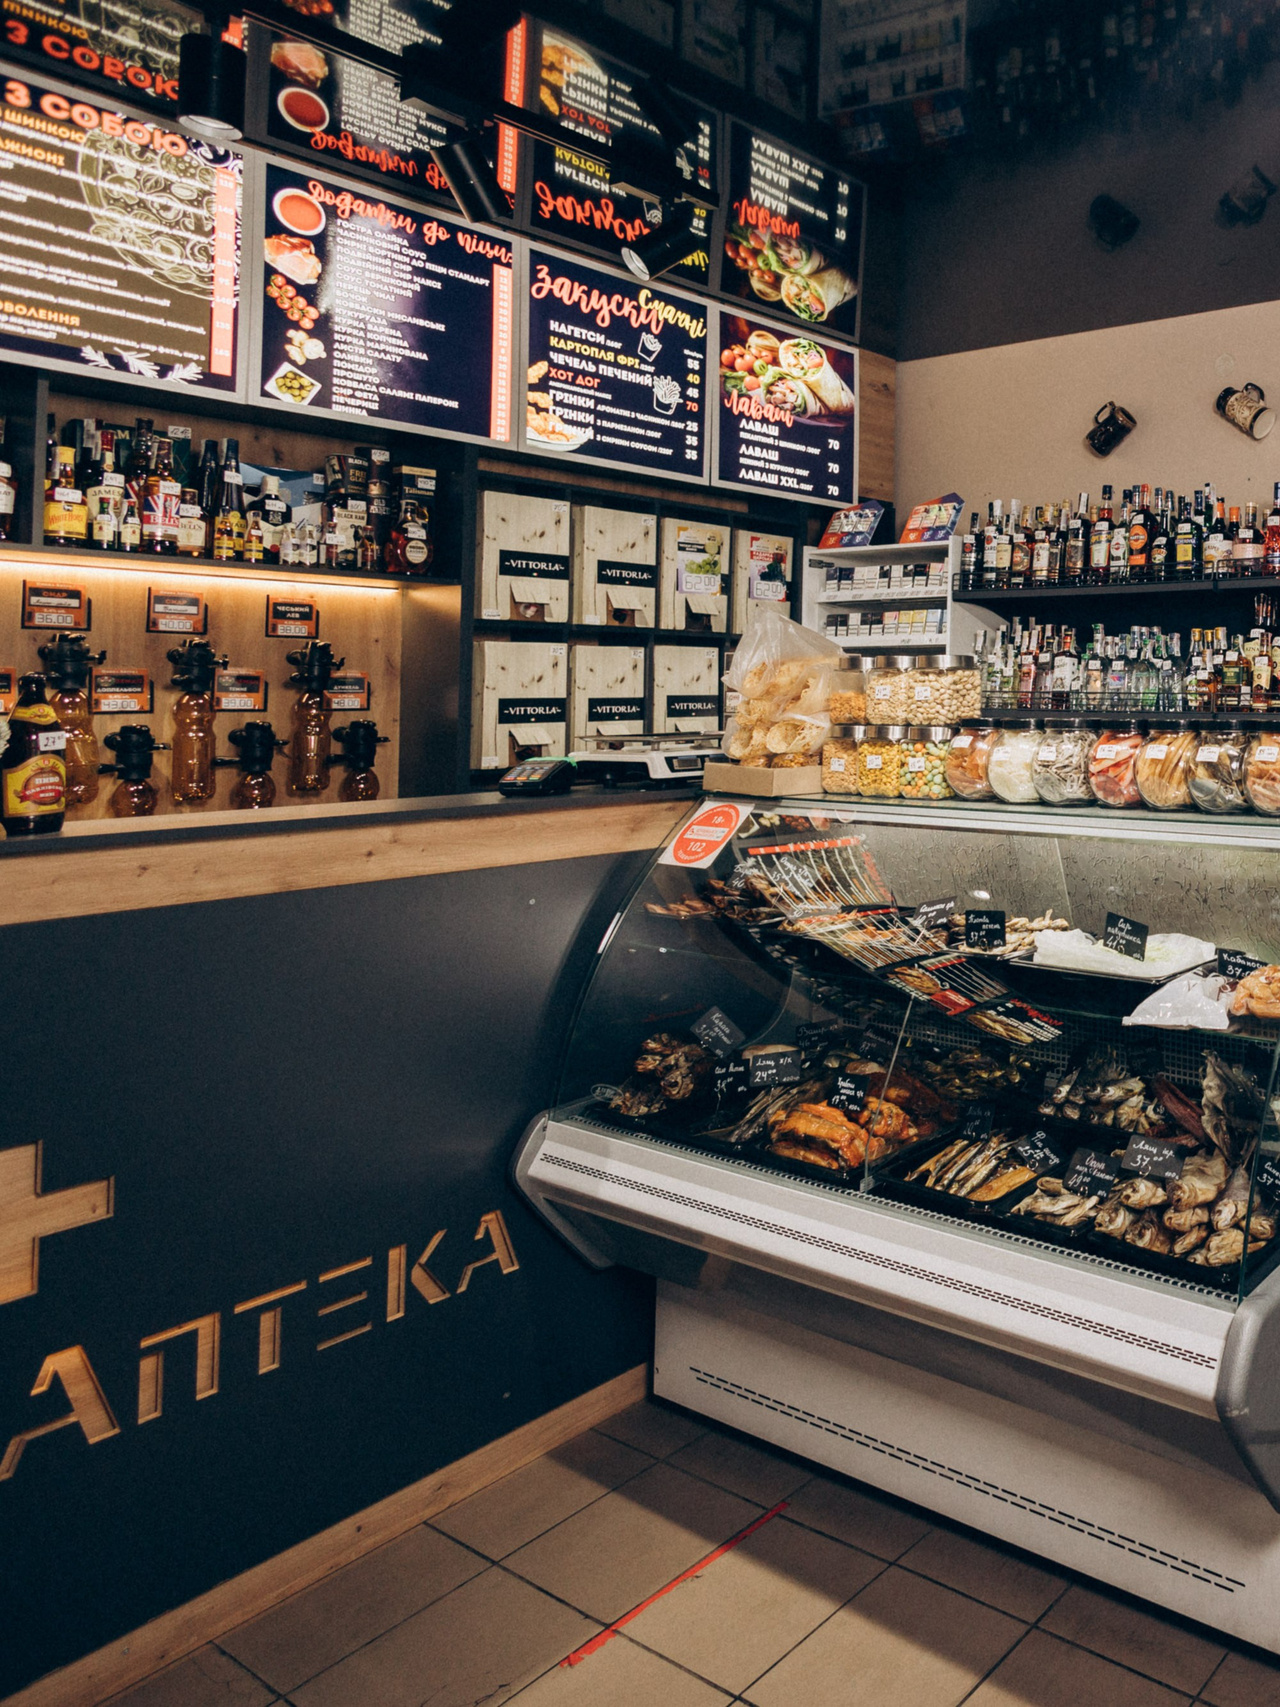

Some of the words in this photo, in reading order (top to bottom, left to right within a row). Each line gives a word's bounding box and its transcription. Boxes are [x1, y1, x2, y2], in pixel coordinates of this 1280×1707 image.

[3, 108, 88, 144] ШИНКОЮ
[4, 80, 31, 109] З
[40, 93, 189, 157] СОБОЮ
[308, 179, 417, 235] Додатки
[422, 220, 451, 246] до
[336, 219, 373, 236] ГОСТРА
[374, 230, 409, 247] ОЛІЙКА
[336, 227, 400, 252] ЧАСНИКОВИЙ
[401, 245, 427, 260] СОУС
[336, 245, 392, 267] ПОДВІЙНИЙ
[393, 261, 413, 272] СИР
[336, 237, 367, 252] СИРНІ
[368, 245, 410, 264] БОРТИКИ
[411, 257, 424, 268] ДО
[447, 268, 490, 286] СТАНДАРТ
[336, 254, 392, 275] ПОДВІЙНИЙ
[392, 269, 412, 281] СИР
[413, 275, 442, 290] МАКСІ
[336, 263, 363, 275] СОУС
[364, 271, 421, 292] ВЕРШКОВИЙ
[335, 281, 372, 297] ПЕРЕЦЬ
[373, 291, 396, 302] ЧИЛІ
[336, 272, 362, 285] СОУС
[364, 279, 413, 298] ТОМАТНИЙ
[530, 264, 665, 335] Закуски
[335, 298, 386, 316] КОВБАСКИ
[386, 311, 446, 331] МИСЛИВСЬКІ
[335, 307, 388, 325] КУКУРУДЗА
[638, 289, 707, 339] Смачні
[334, 316, 365, 329] КУРКА
[366, 323, 403, 338] ВАРЕНА
[334, 324, 365, 338] КУРКА
[366, 331, 409, 348] КОПЧЕНА
[549, 320, 606, 343] НАГЕТСИ
[332, 351, 373, 365] ОЛИВКИ
[333, 342, 365, 355] ЛИСТЯ
[366, 349, 403, 363] САЛАТУ
[334, 333, 365, 346] КУРКА
[366, 340, 429, 361] МАРИНОВАНА
[549, 335, 615, 363] КАРТОПЛЯ
[616, 354, 640, 369] ФРІ
[332, 360, 378, 374] ПОМІДОР
[549, 351, 597, 373] ЧЕЧЕЛЬ
[598, 364, 653, 387] ПЕЧЕНИЙ
[686, 358, 700, 371] 55
[332, 368, 380, 384] ПРОШУТО
[548, 366, 574, 382] ХОТ
[575, 373, 601, 388] ДОГ
[686, 373, 700, 385] 40
[332, 377, 378, 392] КОВБАСА
[379, 386, 414, 400] САЛЯМІ
[414, 393, 459, 409] ПАПЕРОНІ
[332, 386, 353, 396] СИР
[354, 390, 380, 401] ФЕТА
[332, 395, 379, 410] ПЕЧЕРИЦІ
[685, 387, 699, 399] 45
[331, 404, 368, 416] ШИНКА
[549, 389, 595, 409] ГРІНКИ
[685, 420, 699, 433] 25
[685, 401, 699, 412] 70
[724, 389, 794, 428] Лаваш
[548, 405, 595, 425] ГРІНКИ
[685, 435, 698, 447] 35
[739, 418, 779, 436] ЛАВАШ
[684, 449, 698, 461] 35
[739, 444, 779, 461] ЛАВАШ
[828, 439, 840, 450] 70
[828, 462, 840, 474] 70
[739, 468, 779, 485] ЛАВАШ
[780, 476, 799, 488] XXL
[827, 485, 839, 496] 70
[511, 559, 558, 572] VITTORIA
[607, 568, 647, 580] VITTORIA
[509, 706, 556, 716] VITTORIA
[597, 704, 635, 714] VITTORIA
[675, 701, 710, 711] VITTORIA
[687, 841, 706, 852] 102
